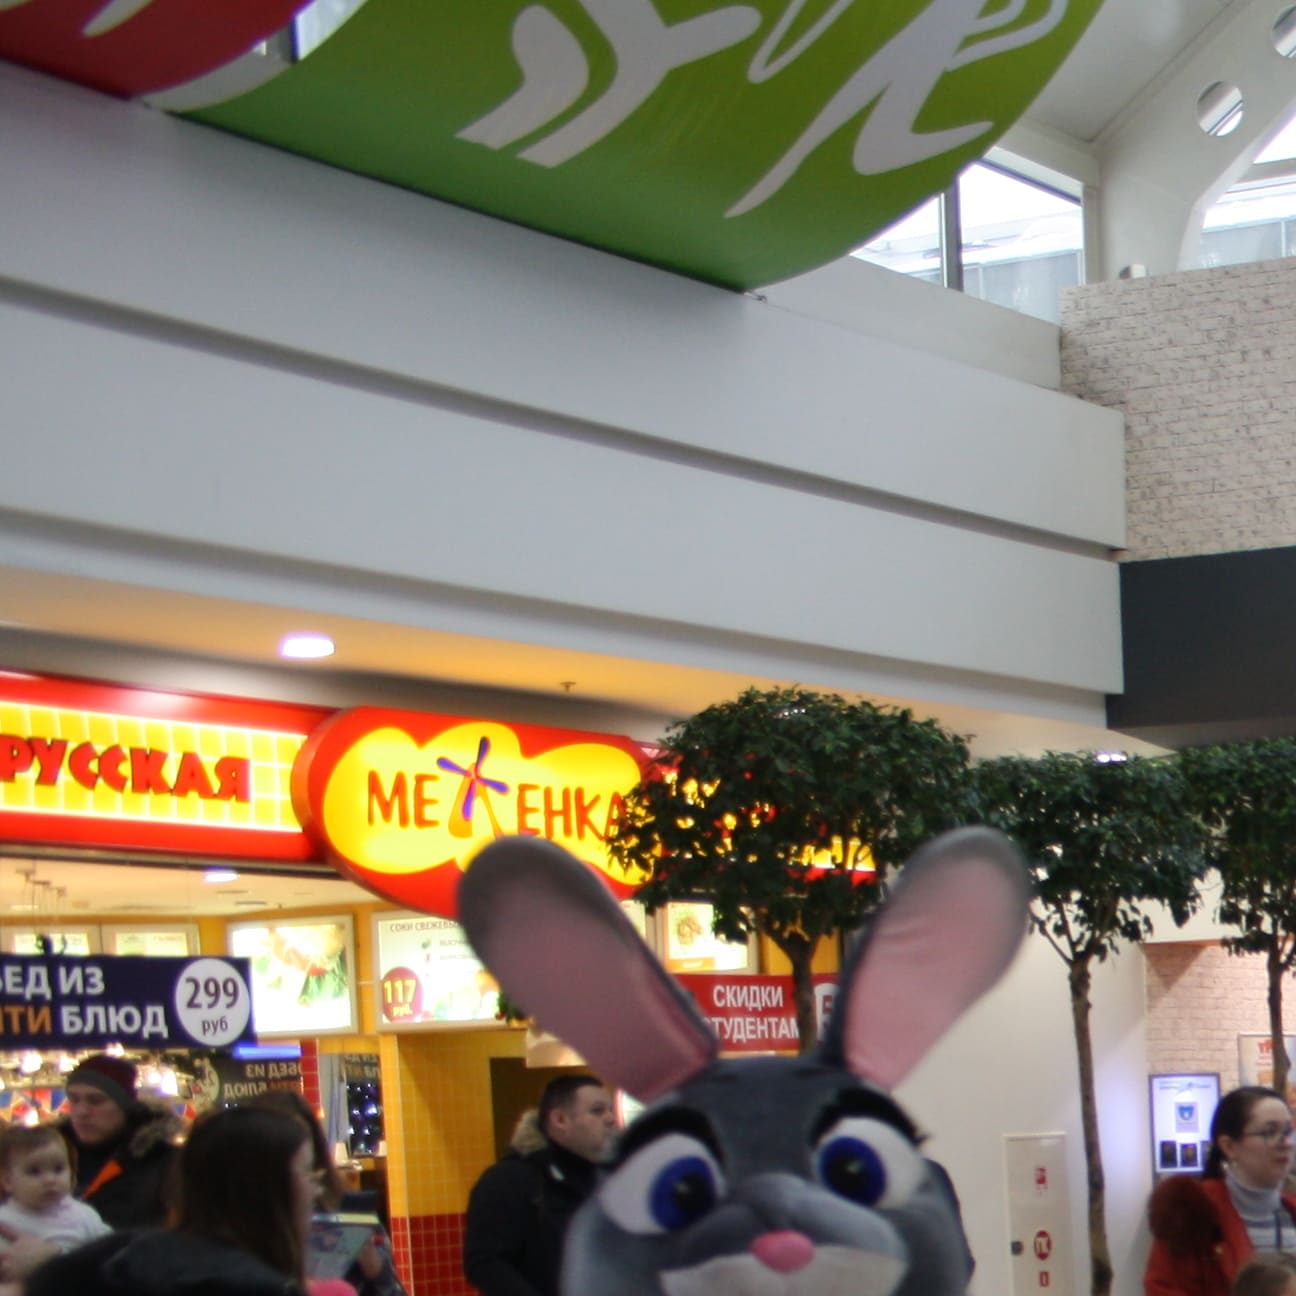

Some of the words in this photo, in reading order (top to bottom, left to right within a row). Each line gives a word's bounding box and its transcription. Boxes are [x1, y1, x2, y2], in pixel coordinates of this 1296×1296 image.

[0, 733, 250, 803] РУССКАЯ
[0, 965, 52, 1000] ЕД
[59, 965, 106, 996] ИЗ
[185, 976, 240, 1010] 299
[383, 979, 416, 1004] 117
[713, 985, 784, 1011] СКИДКИ
[0, 1004, 51, 1036] ТИ
[60, 1004, 169, 1039] БЛЮД
[201, 1017, 229, 1036] руб
